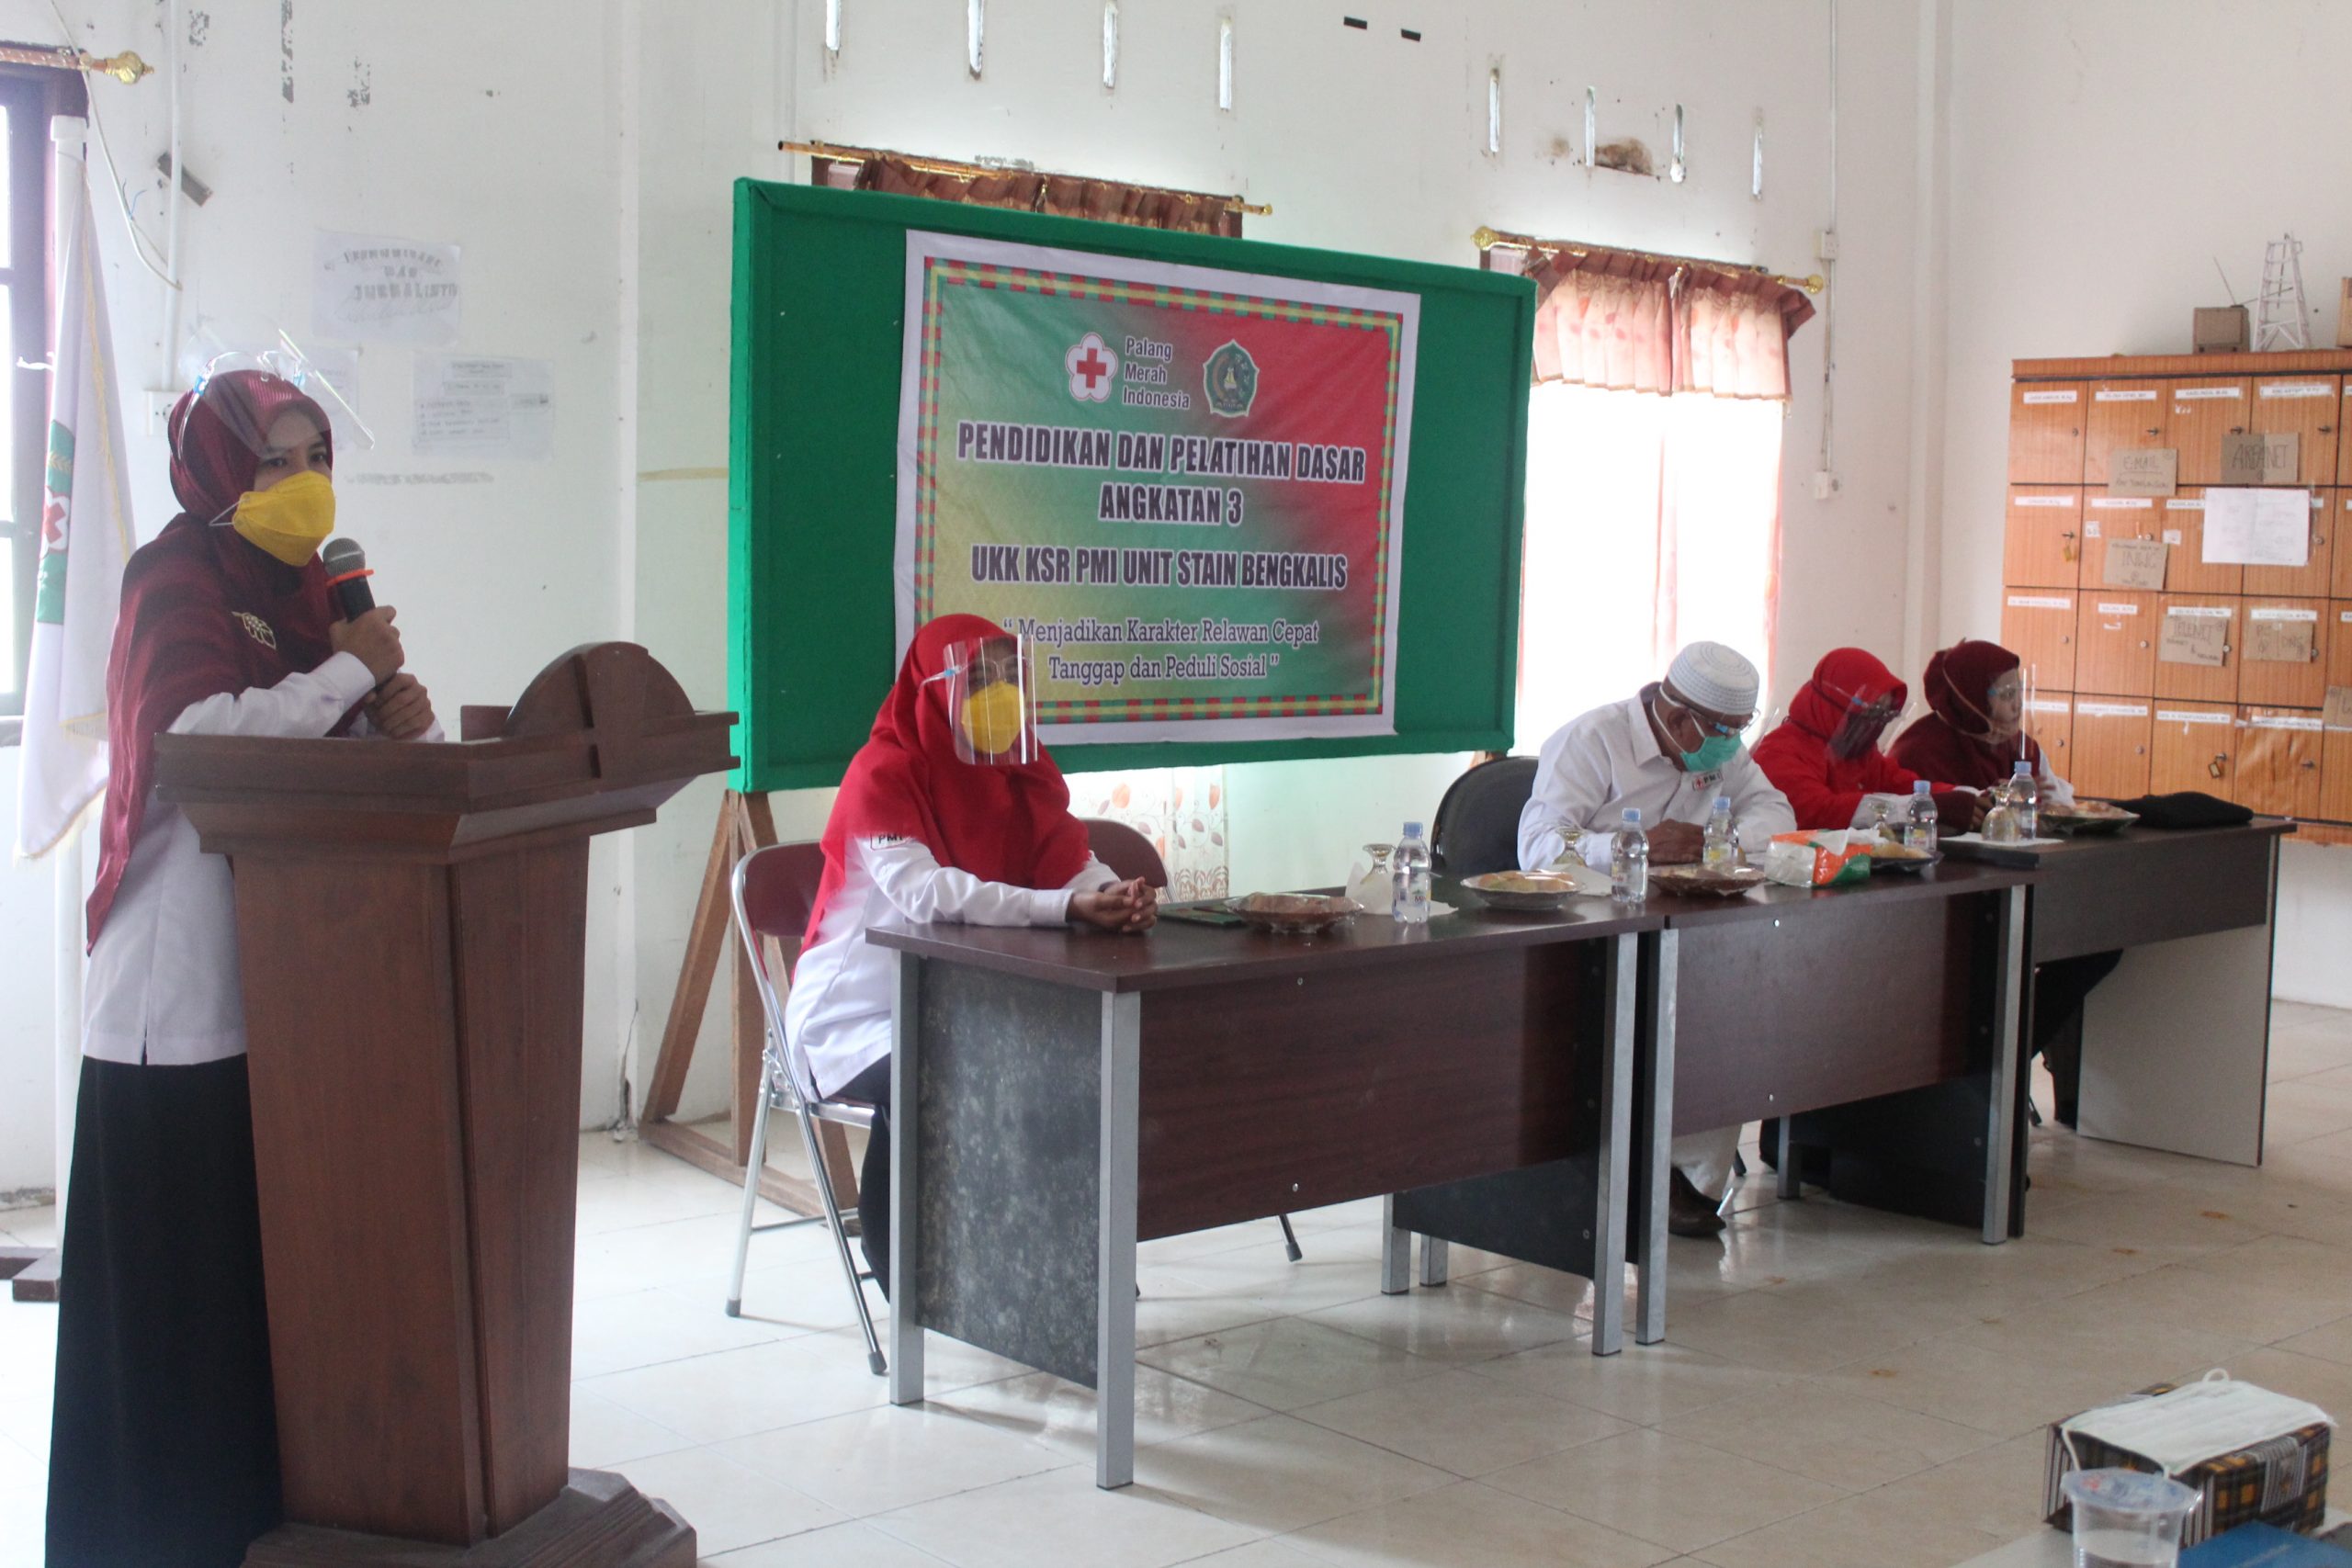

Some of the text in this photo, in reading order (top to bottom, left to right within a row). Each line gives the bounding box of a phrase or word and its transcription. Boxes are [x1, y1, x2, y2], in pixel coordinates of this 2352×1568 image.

[1125, 336, 1172, 361] Palang
[1125, 363, 1167, 384] Merah
[1123, 387, 1191, 409] Indonesia
[957, 421, 1366, 482] PENDIDIKAN DAN PELATIHAN DASAR
[1099, 483, 1242, 525] ANGKATAN 3
[971, 544, 1347, 589] UKK KSR PMI UNIT STAIN BENGKALIS
[1018, 617, 1123, 648] Menjadikan
[1125, 618, 1198, 642] Karakter
[1202, 618, 1269, 642] Relawan
[1272, 619, 1318, 648] Cepat
[1048, 656, 1125, 686] Tanggap
[1129, 655, 1162, 679] dan
[1165, 655, 1216, 678] Peduli
[1220, 655, 1266, 677] Sosial
